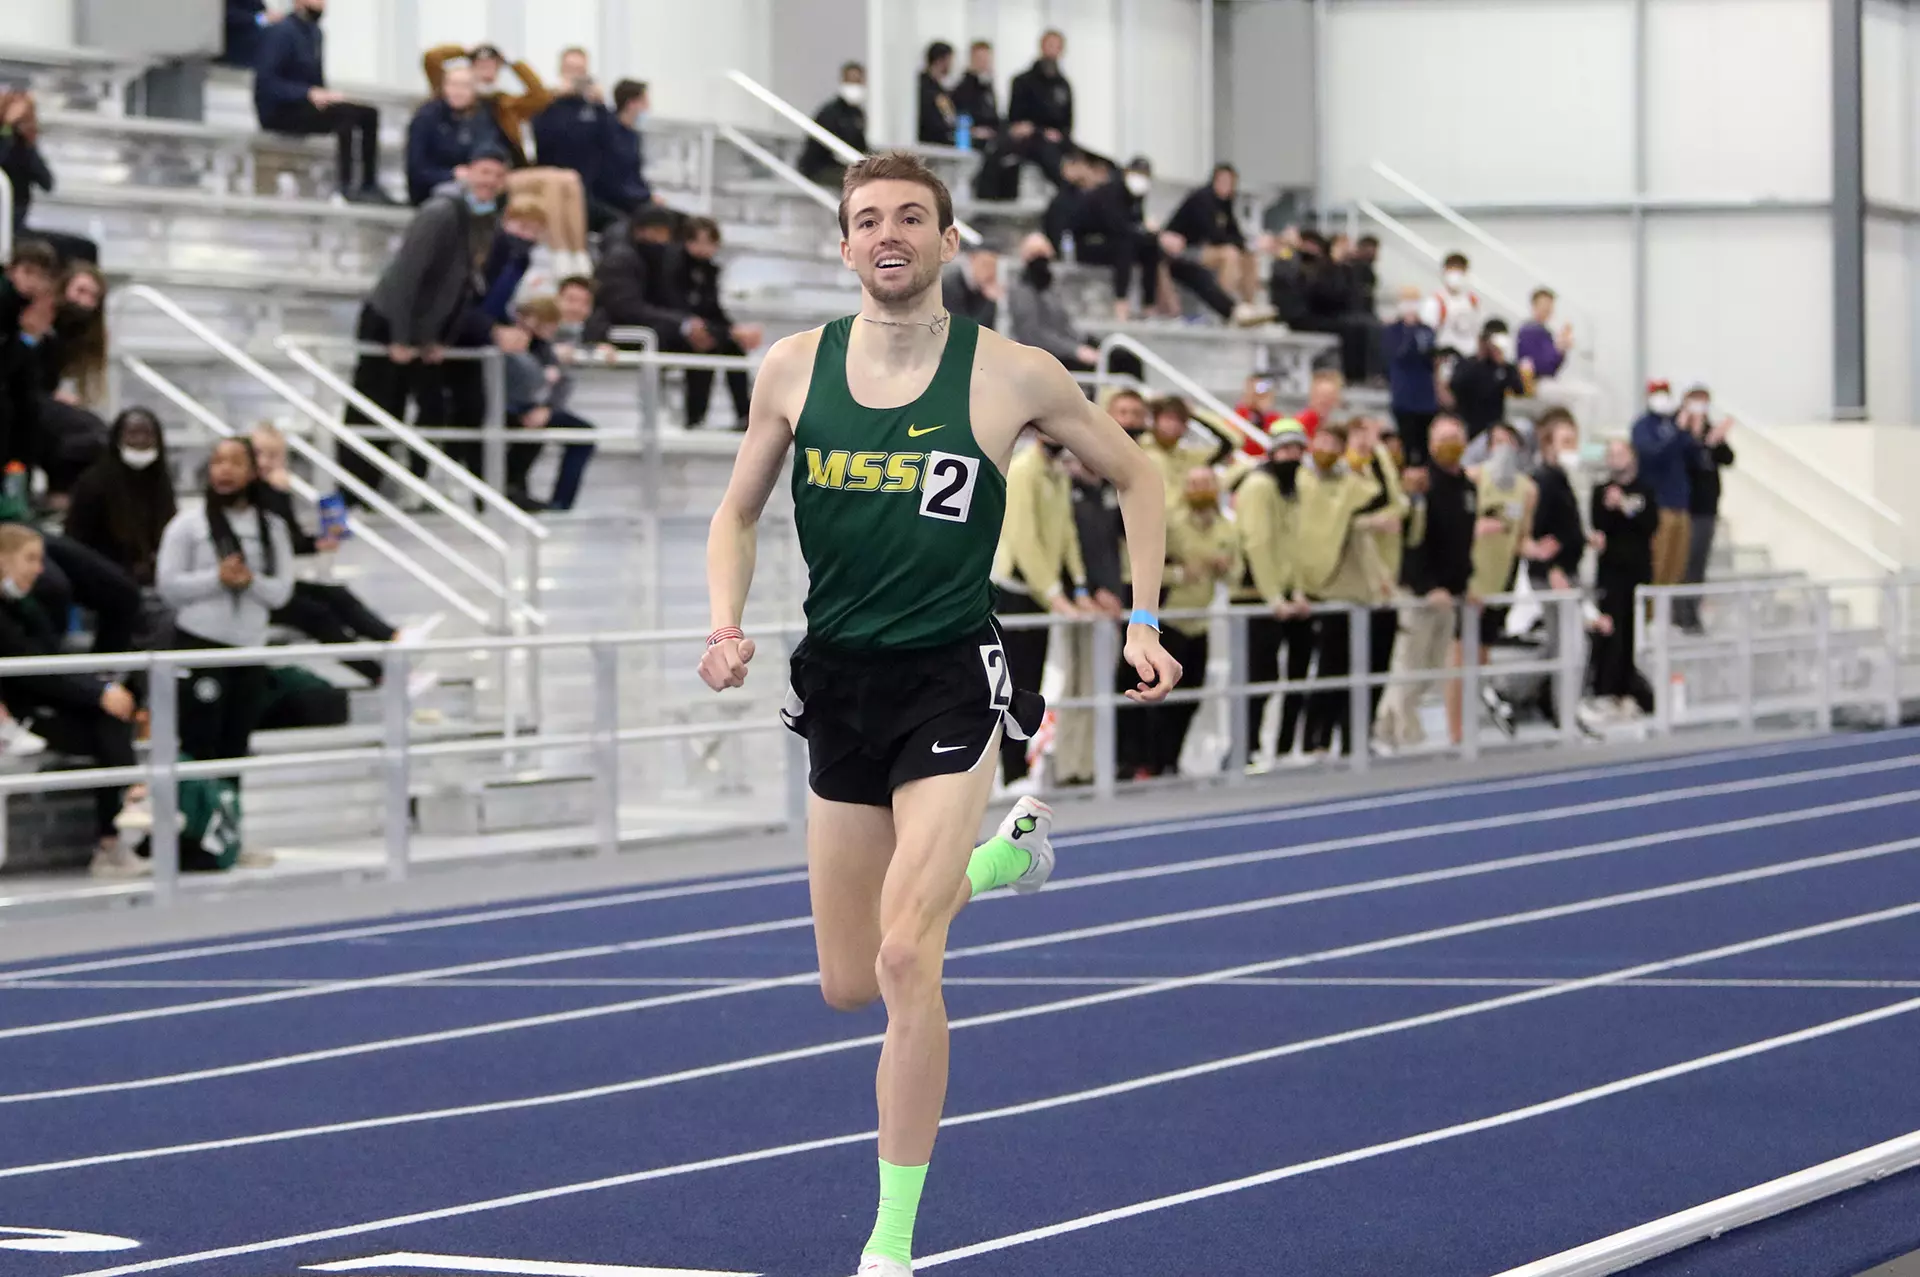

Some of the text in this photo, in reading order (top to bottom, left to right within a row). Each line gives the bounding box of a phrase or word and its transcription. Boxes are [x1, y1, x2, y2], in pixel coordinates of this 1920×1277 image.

[805, 448, 932, 492] MSS
[926, 459, 968, 517] 2
[988, 649, 1009, 706] 2
